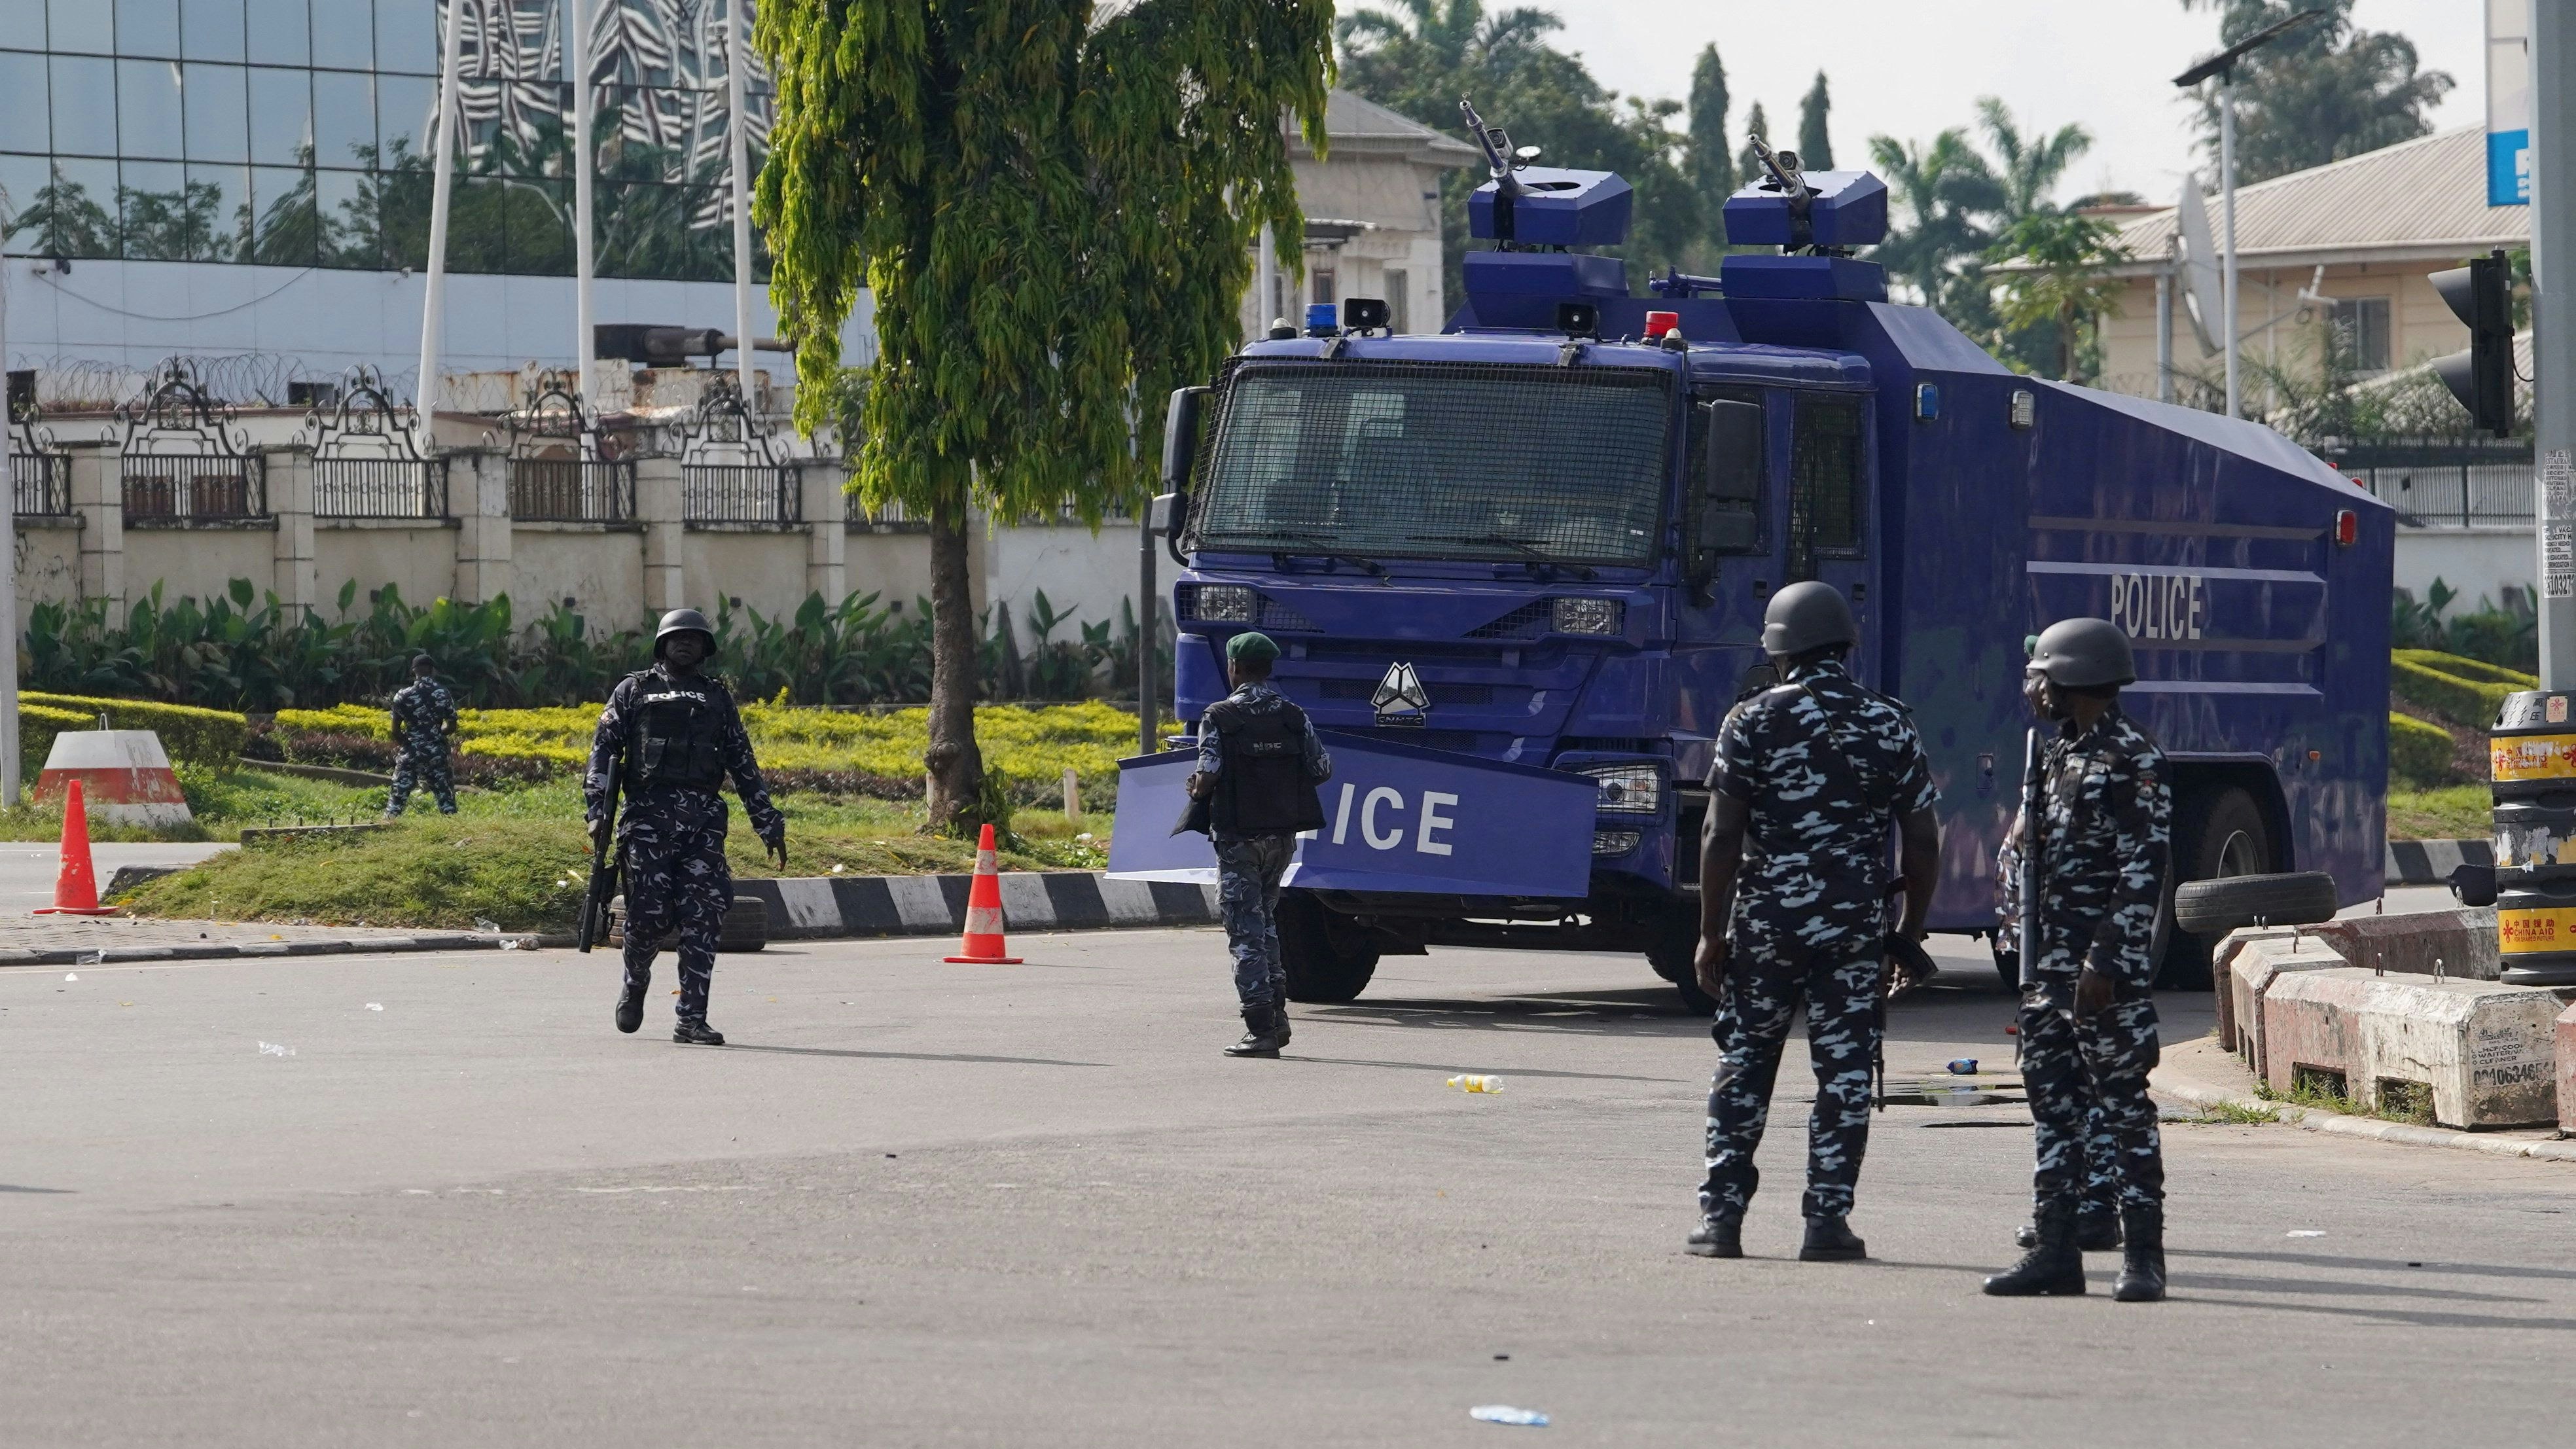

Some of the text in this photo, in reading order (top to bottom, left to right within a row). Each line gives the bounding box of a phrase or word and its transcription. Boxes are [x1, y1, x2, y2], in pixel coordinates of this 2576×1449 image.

[2111, 571, 2202, 640] POLICE
[647, 691, 706, 702] POLICE
[1296, 783, 1459, 856] ICE
[2514, 927, 2554, 937] CHINA AID
